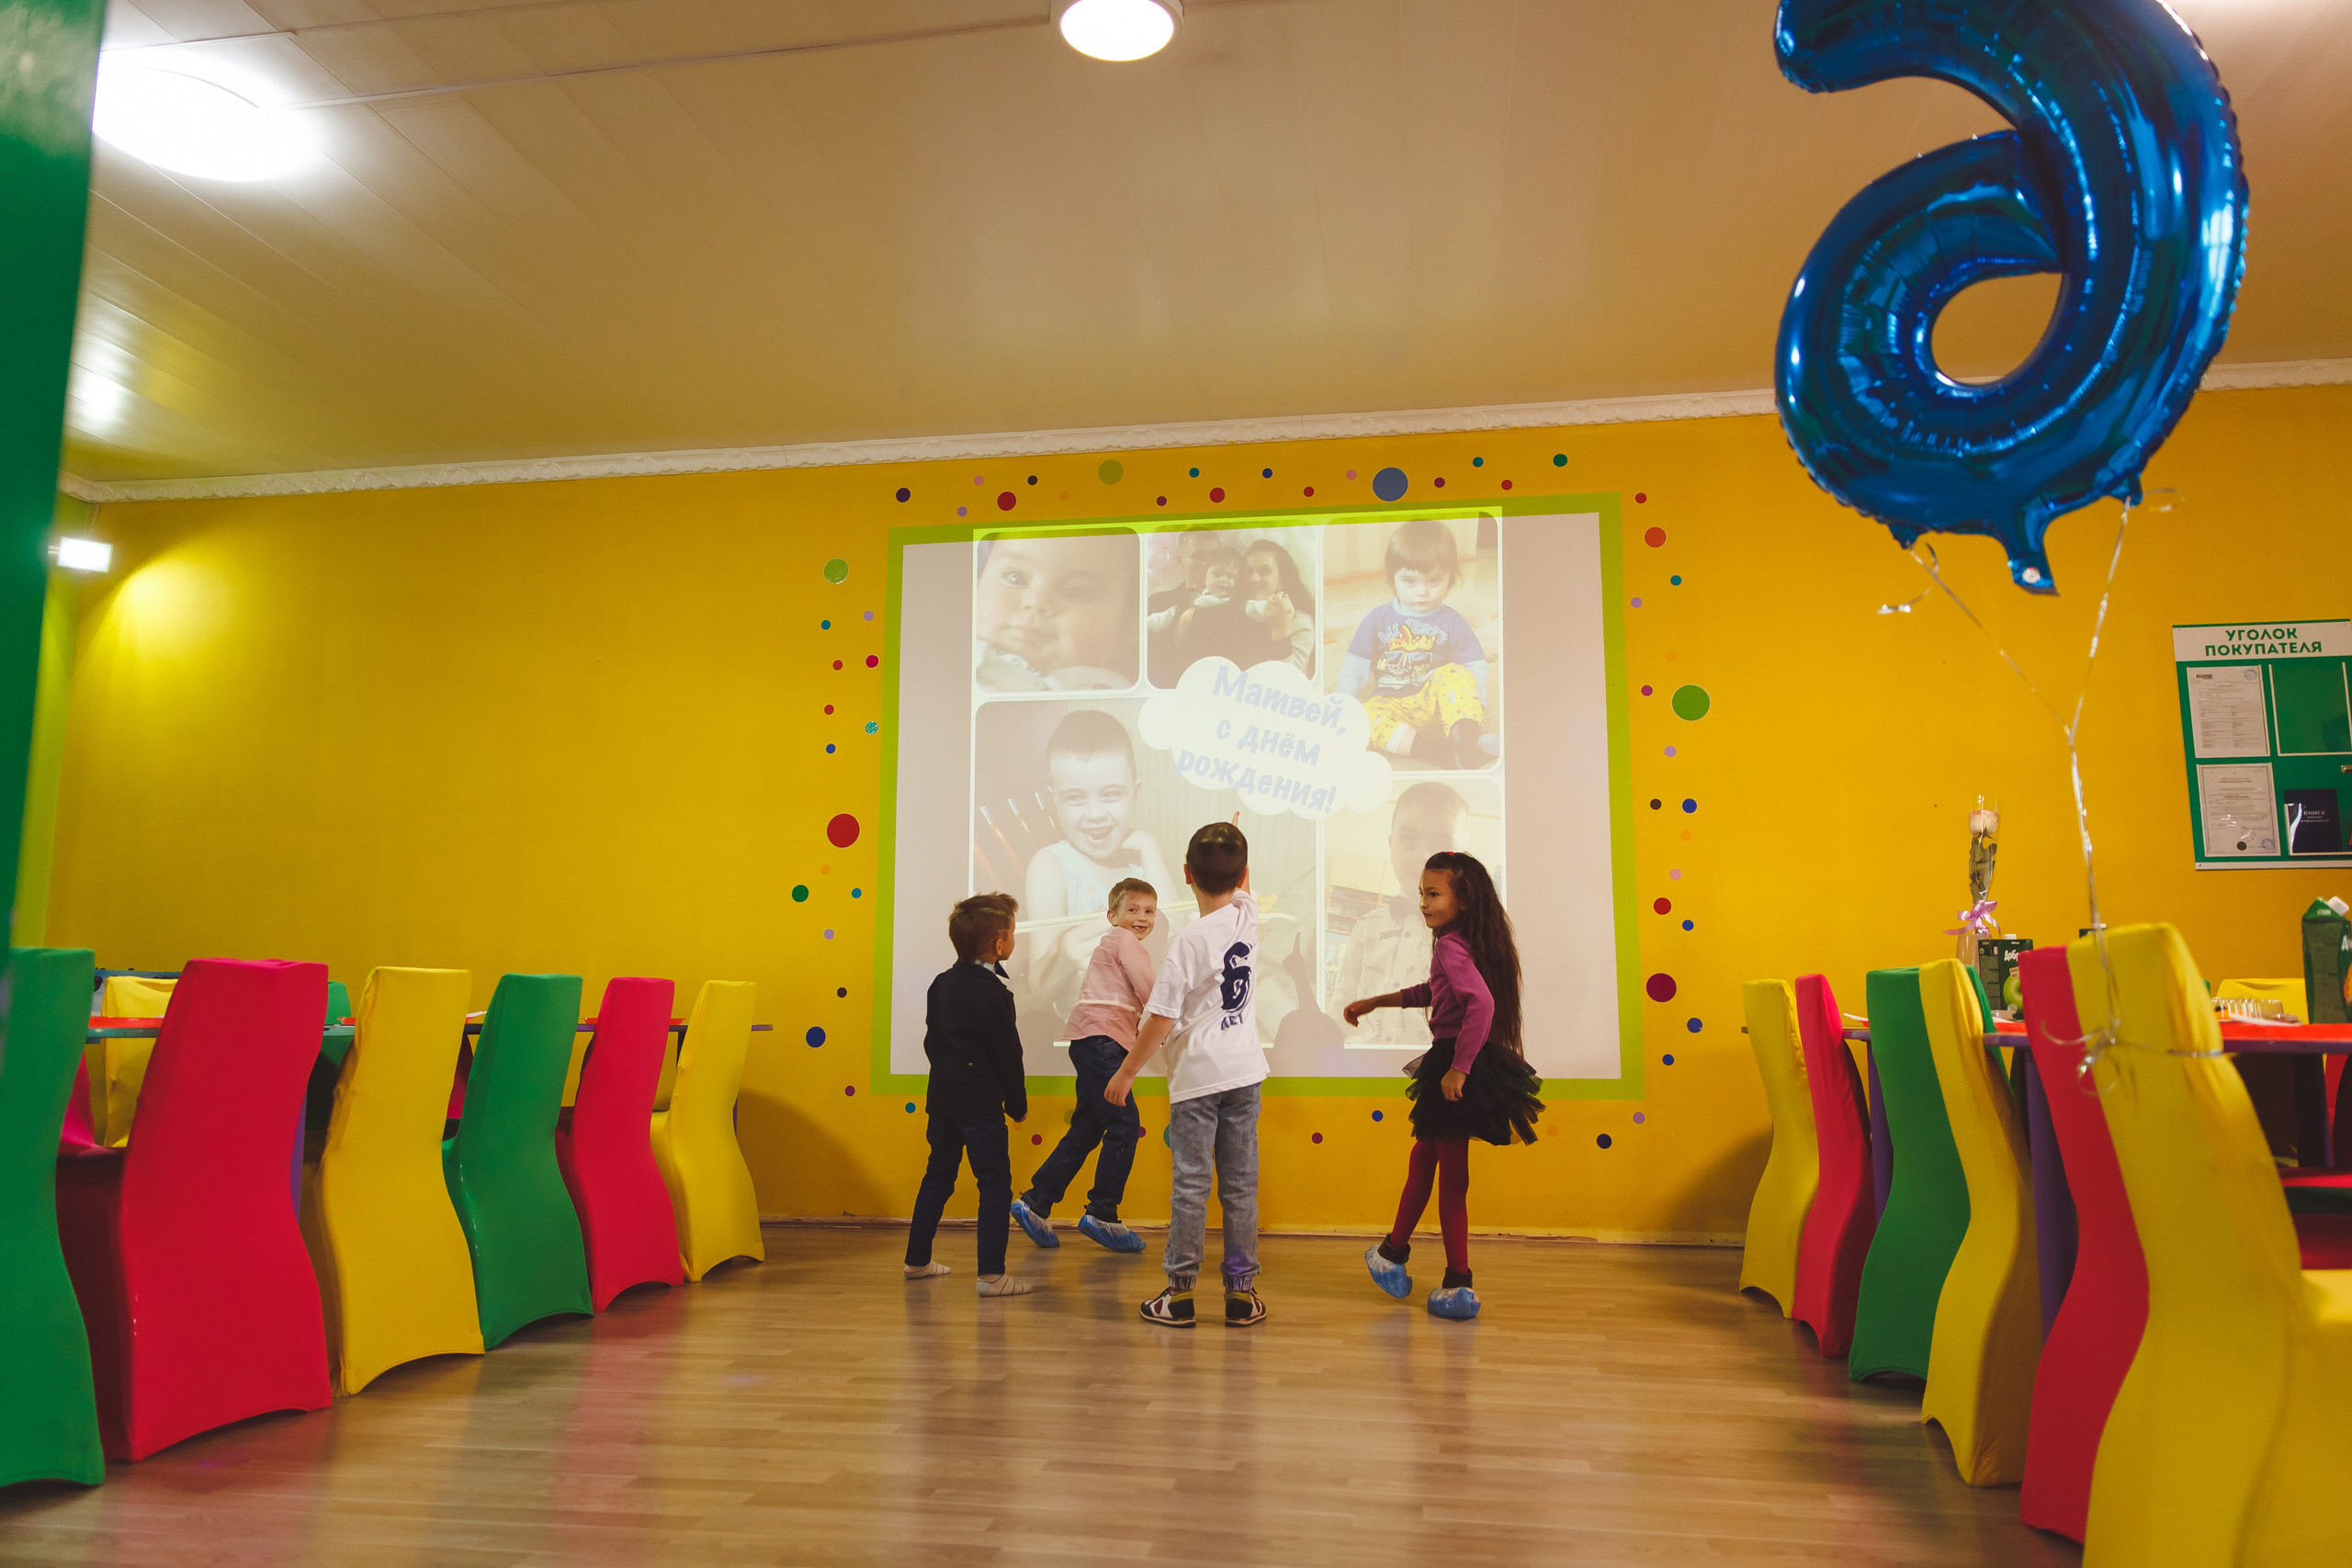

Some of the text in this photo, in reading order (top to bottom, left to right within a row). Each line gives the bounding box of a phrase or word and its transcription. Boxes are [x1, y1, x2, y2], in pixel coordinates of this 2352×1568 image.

[2205, 641, 2323, 657] ПОКУПАТЕЛЯ
[2225, 627, 2298, 641] УГОЛОК
[1212, 665, 1347, 736] Матвей,
[1216, 719, 1321, 767] с днём
[1174, 750, 1338, 815] рождения!
[1220, 942, 1252, 1013] 6
[1220, 1013, 1244, 1032] ЛЕТ
